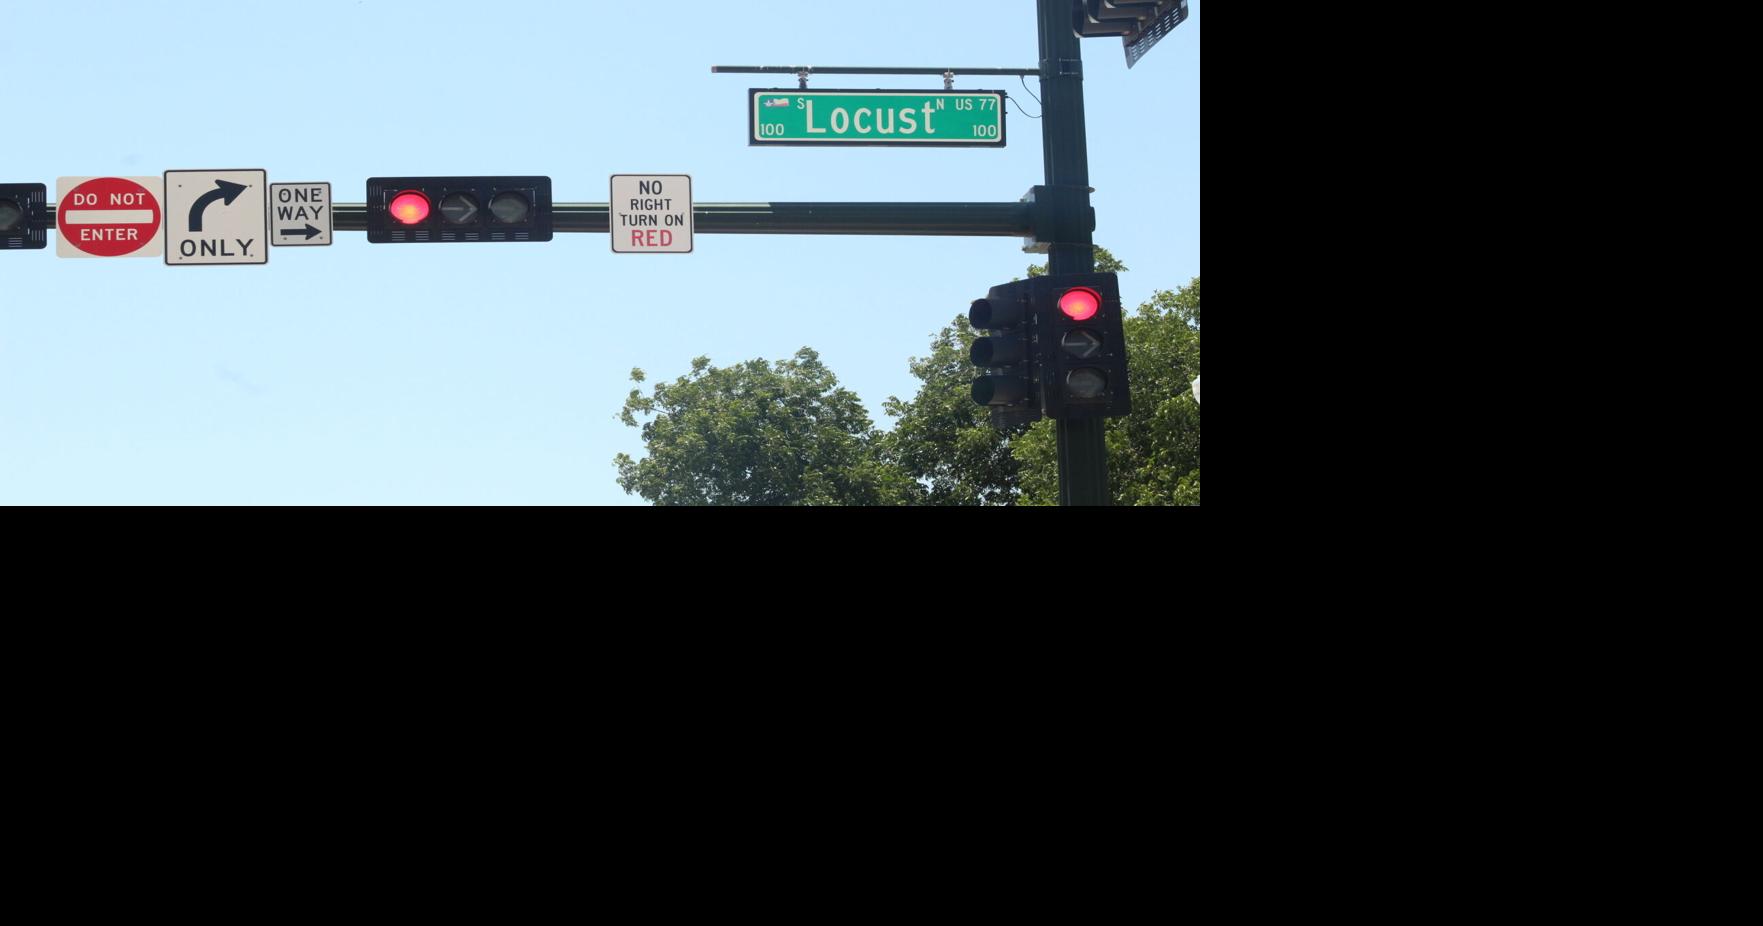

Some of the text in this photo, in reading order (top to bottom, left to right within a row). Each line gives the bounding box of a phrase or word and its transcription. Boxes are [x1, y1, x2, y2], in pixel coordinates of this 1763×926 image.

[797, 97, 996, 135] S Locust N US 77
[760, 123, 784, 136] 100
[972, 124, 997, 137] 100
[639, 180, 662, 195] NO
[73, 192, 145, 206] DO NOT
[278, 187, 323, 203] ONE
[630, 198, 672, 211] RIGHT
[277, 205, 324, 221] WAY
[620, 214, 684, 226] TURN ON
[80, 228, 138, 241] ENTER
[631, 229, 673, 247] RED
[180, 238, 254, 257] ONLY
